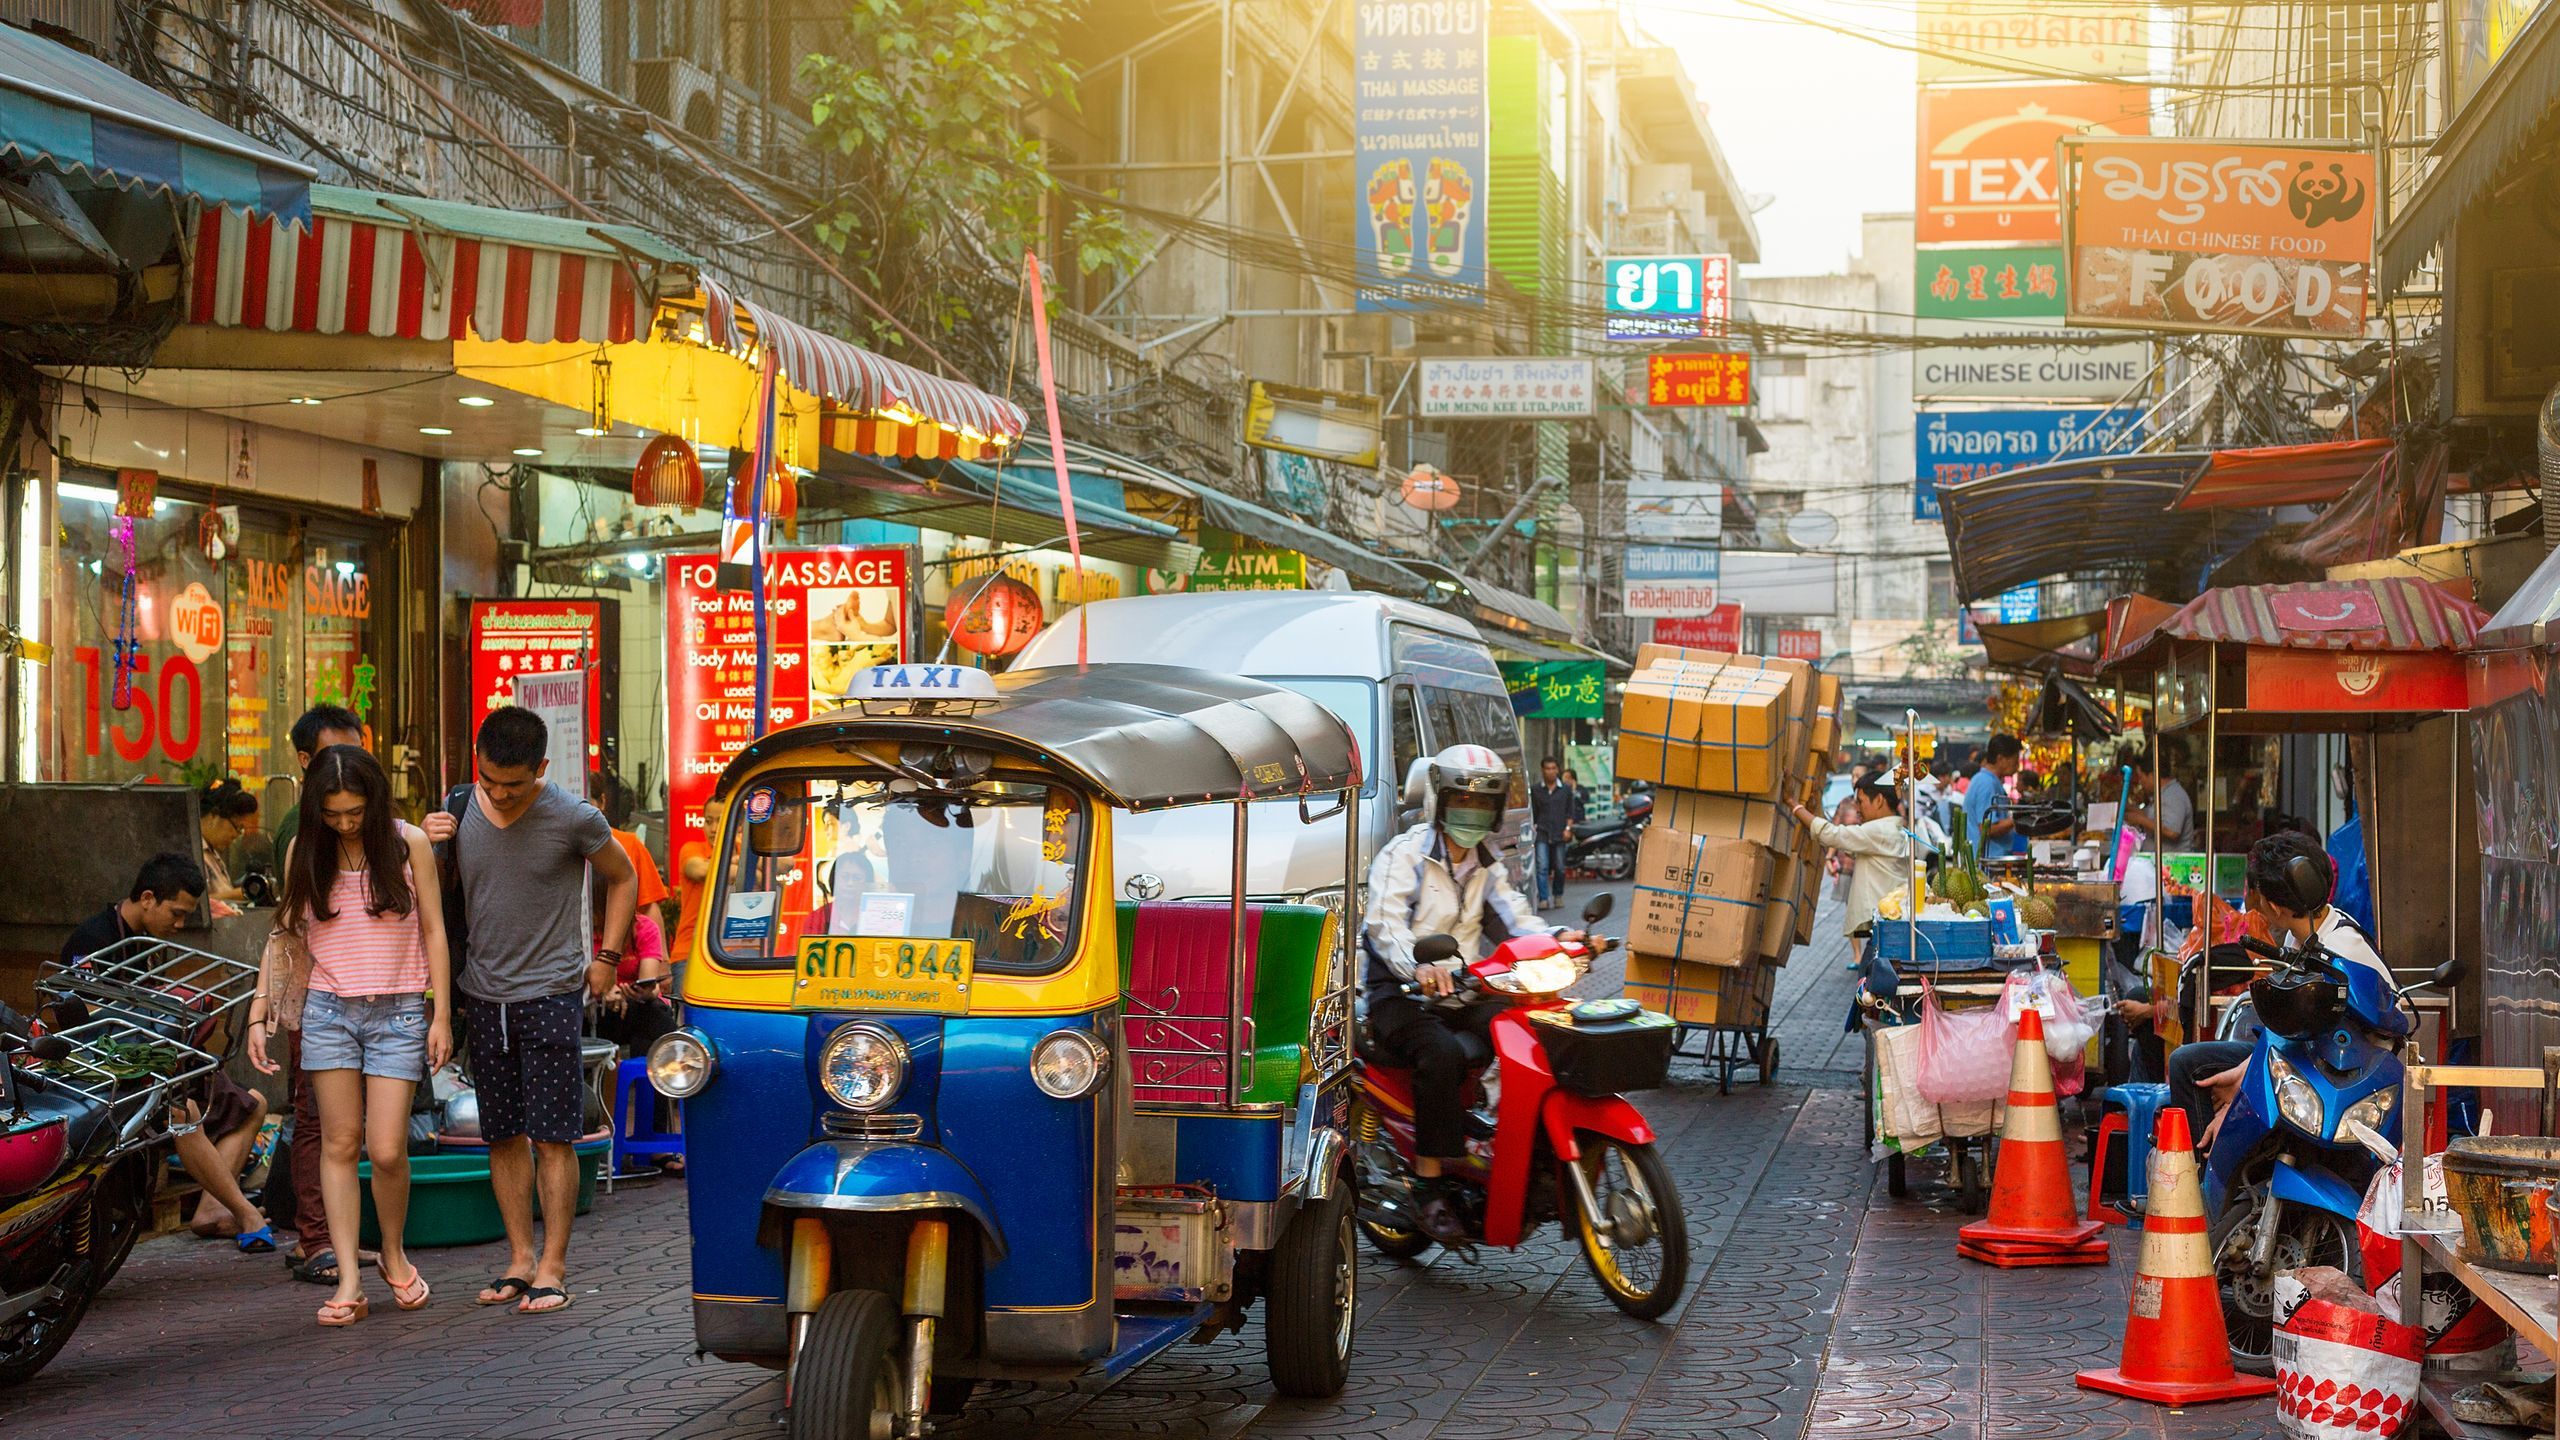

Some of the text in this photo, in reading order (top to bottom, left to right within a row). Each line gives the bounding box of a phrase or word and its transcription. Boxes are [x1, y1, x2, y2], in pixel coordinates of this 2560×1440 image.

[1361, 77, 1479, 97] THAI MASSAGE
[2121, 227, 2326, 254] THAI CHINESE FOOD
[1616, 262, 1693, 311] ยา
[2129, 248, 2332, 320] FOOD
[1925, 361, 2138, 383] CHINESE CUISINE
[1426, 402, 1449, 413] LIM
[1453, 402, 1488, 412] MENG
[1493, 402, 1517, 412] KEE
[1927, 414, 2037, 455] ที่จอดรถ
[679, 564, 716, 588] FO
[1223, 555, 1279, 575] ATM
[247, 558, 371, 619] MAS SAGE
[690, 597, 722, 613] Foot
[689, 650, 726, 670] Body
[871, 667, 962, 687] TAXI
[1542, 674, 1601, 704] 如意
[74, 647, 201, 762] 150
[696, 704, 720, 720] Oil
[806, 938, 963, 981] สก 5844
